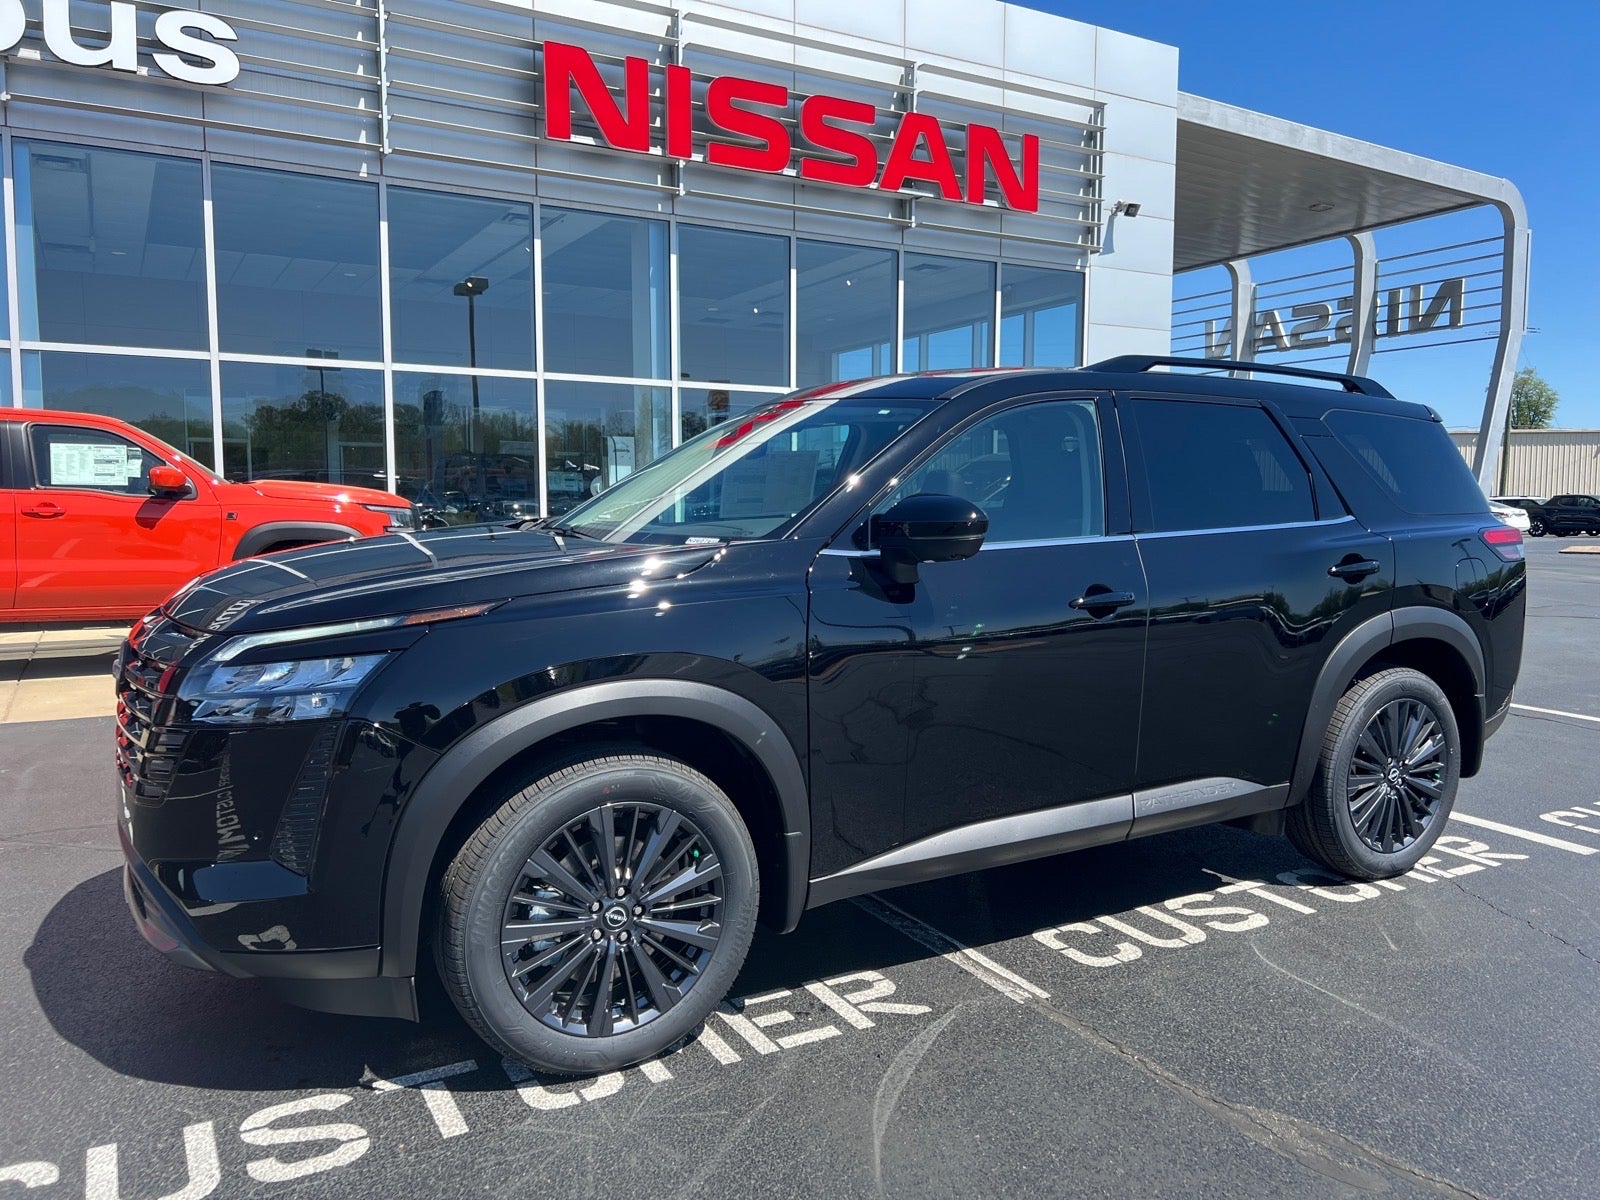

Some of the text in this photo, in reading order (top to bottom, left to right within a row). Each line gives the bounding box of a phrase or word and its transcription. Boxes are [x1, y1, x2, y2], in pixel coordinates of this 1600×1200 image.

[543, 40, 1039, 213] NISSAN
[1140, 781, 1238, 810] PATHFINDER
[0, 969, 934, 1200] USTOER
